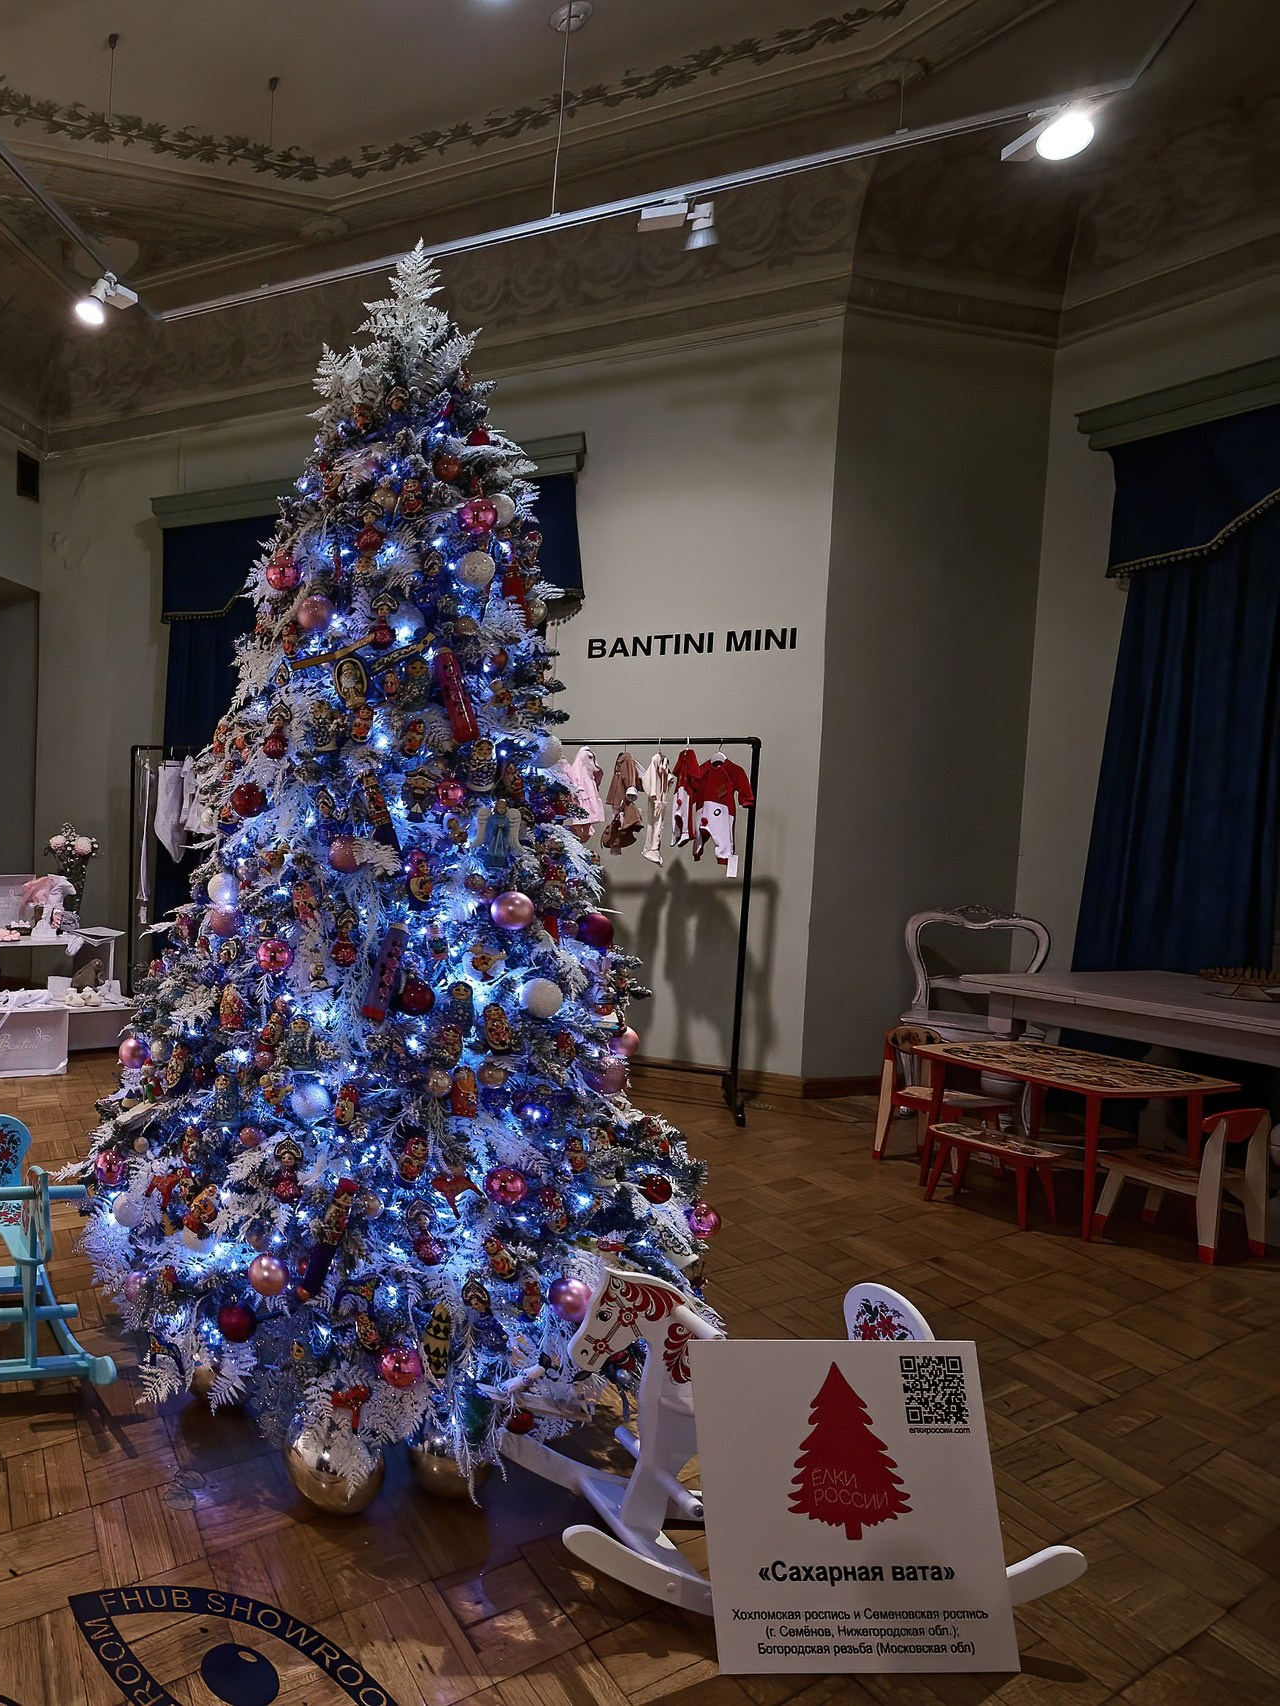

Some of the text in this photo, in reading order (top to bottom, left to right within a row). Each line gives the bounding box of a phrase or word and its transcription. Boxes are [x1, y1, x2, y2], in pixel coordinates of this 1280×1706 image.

[587, 627, 797, 659] BANTINI MINI
[811, 1467, 858, 1489] ЁЛКИ
[814, 1486, 889, 1510] РОССИИ
[758, 1560, 956, 1587] «Сахарная вата»
[99, 1588, 192, 1613] FHUB
[732, 1608, 989, 1622] Хохломская роспись и Семеновская роспись
[765, 1625, 776, 1640] (г.
[779, 1625, 835, 1638] Семёнов,
[837, 1625, 925, 1639] Нижегородская
[757, 1641, 976, 1656] Богородская резьба (Московская обл)
[84, 1617, 166, 1706] ROOM
